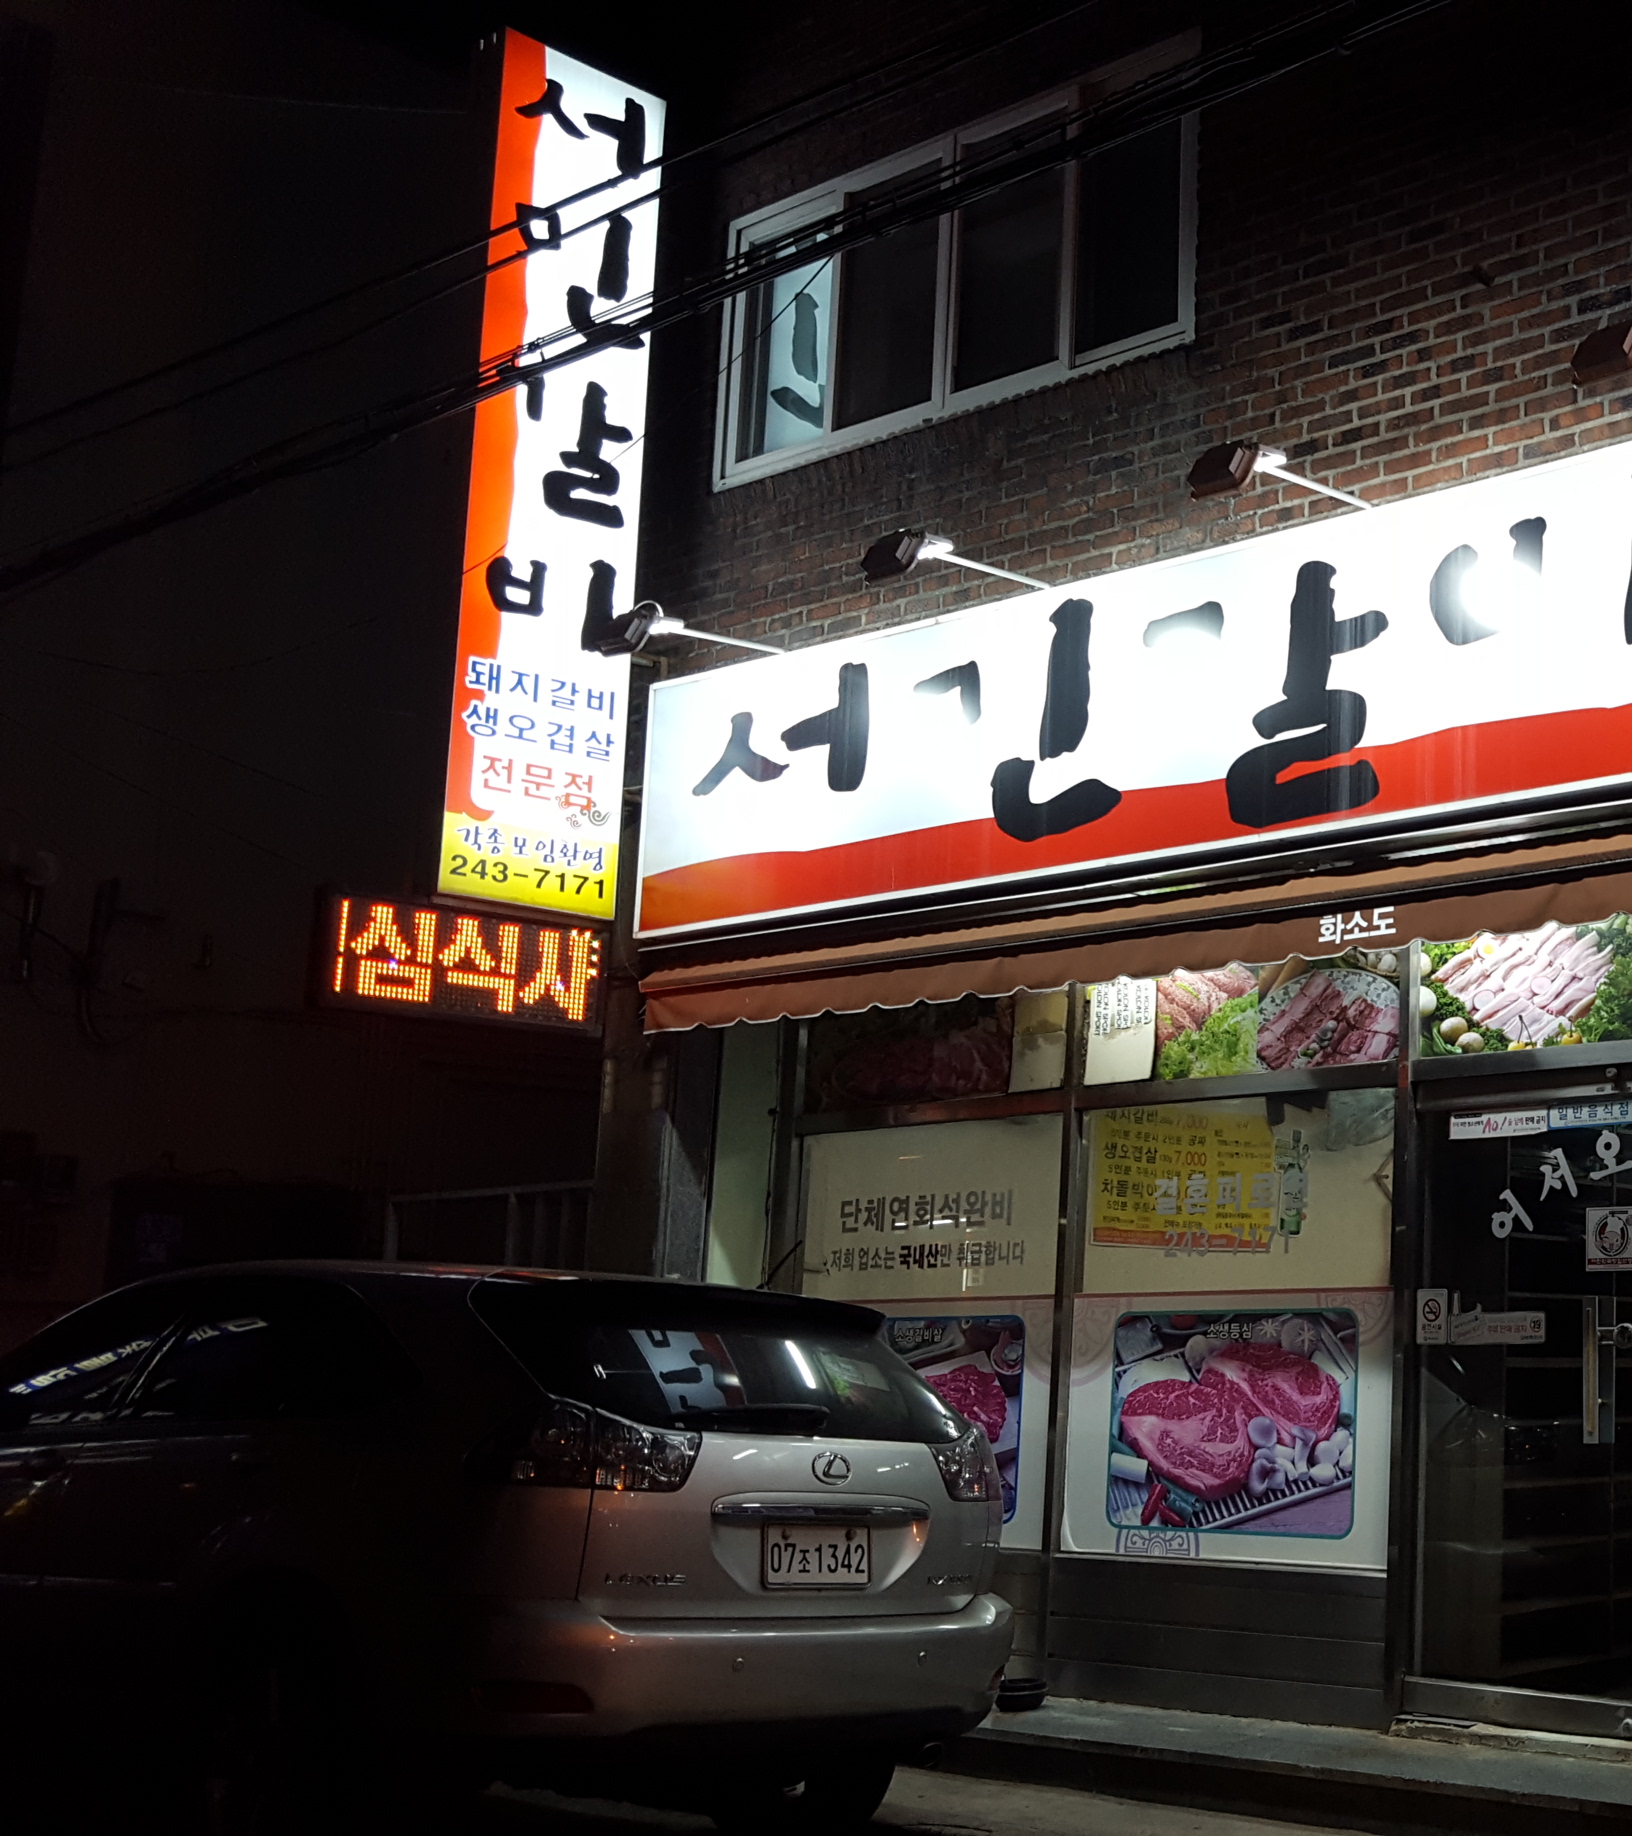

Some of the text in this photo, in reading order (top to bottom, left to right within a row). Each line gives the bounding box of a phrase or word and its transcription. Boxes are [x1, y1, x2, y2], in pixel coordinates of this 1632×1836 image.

[469, 660, 615, 720] 돼지갈비
[466, 703, 615, 762] 생오겹살
[481, 755, 594, 812] 전문점
[449, 854, 605, 899] 243-7171
[1318, 906, 1397, 945] 화소도
[1557, 1101, 1629, 1121] 일반음식점
[1103, 1141, 1159, 1165] 생오겹살
[840, 1188, 1013, 1234] 단체연회석완비
[831, 1239, 1025, 1271] 저희 업소는 국내산만 취급합니다
[1164, 1226, 1291, 1257] 243-7171
[769, 1542, 867, 1576] 07조1342
